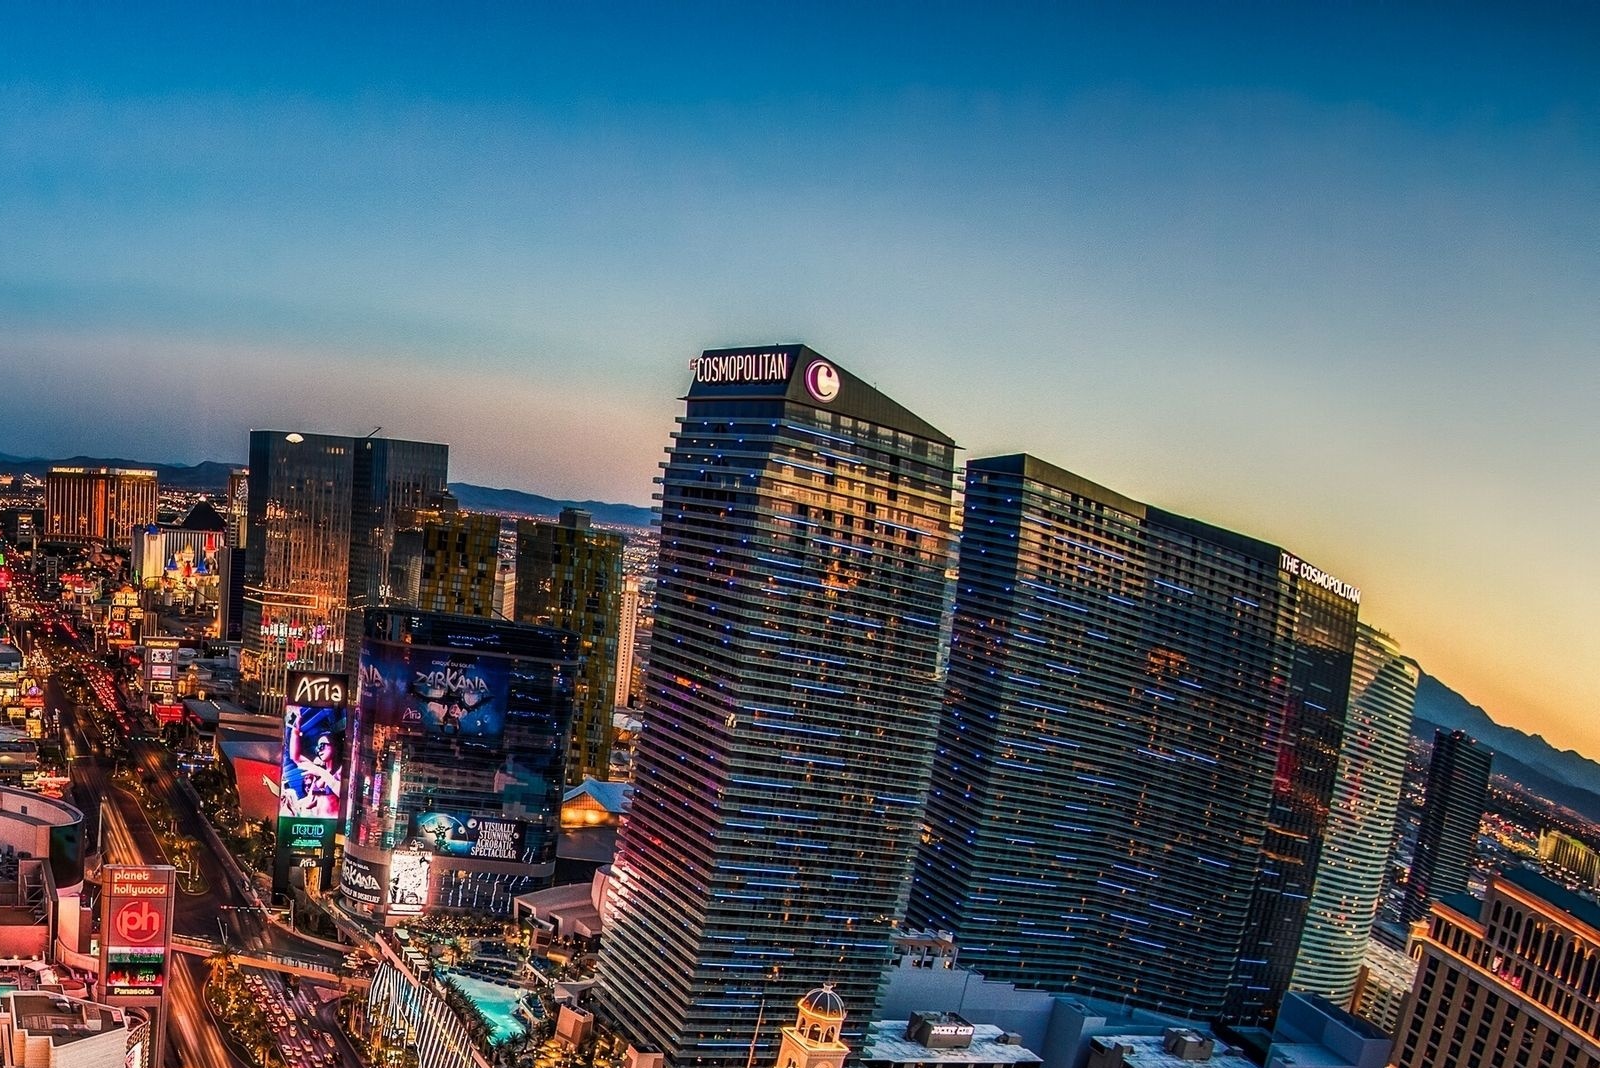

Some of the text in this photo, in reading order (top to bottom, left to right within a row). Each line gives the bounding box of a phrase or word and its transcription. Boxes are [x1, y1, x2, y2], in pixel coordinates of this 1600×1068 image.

[697, 353, 787, 383] COSMOPOLITAN
[1281, 552, 1361, 605] THE COSMOPOLITAN
[416, 668, 489, 692] ZARKANA
[294, 676, 343, 703] Aria
[291, 824, 325, 835] LIQUID
[478, 821, 516, 833] A VISUALLY
[479, 831, 513, 841] STUNNING
[476, 839, 514, 851] ACROBATIC
[471, 847, 517, 859] SPECTACULAR
[114, 870, 150, 882] planet
[113, 883, 167, 896] hollywood
[121, 902, 160, 937] ph
[146, 974, 156, 982] $10
